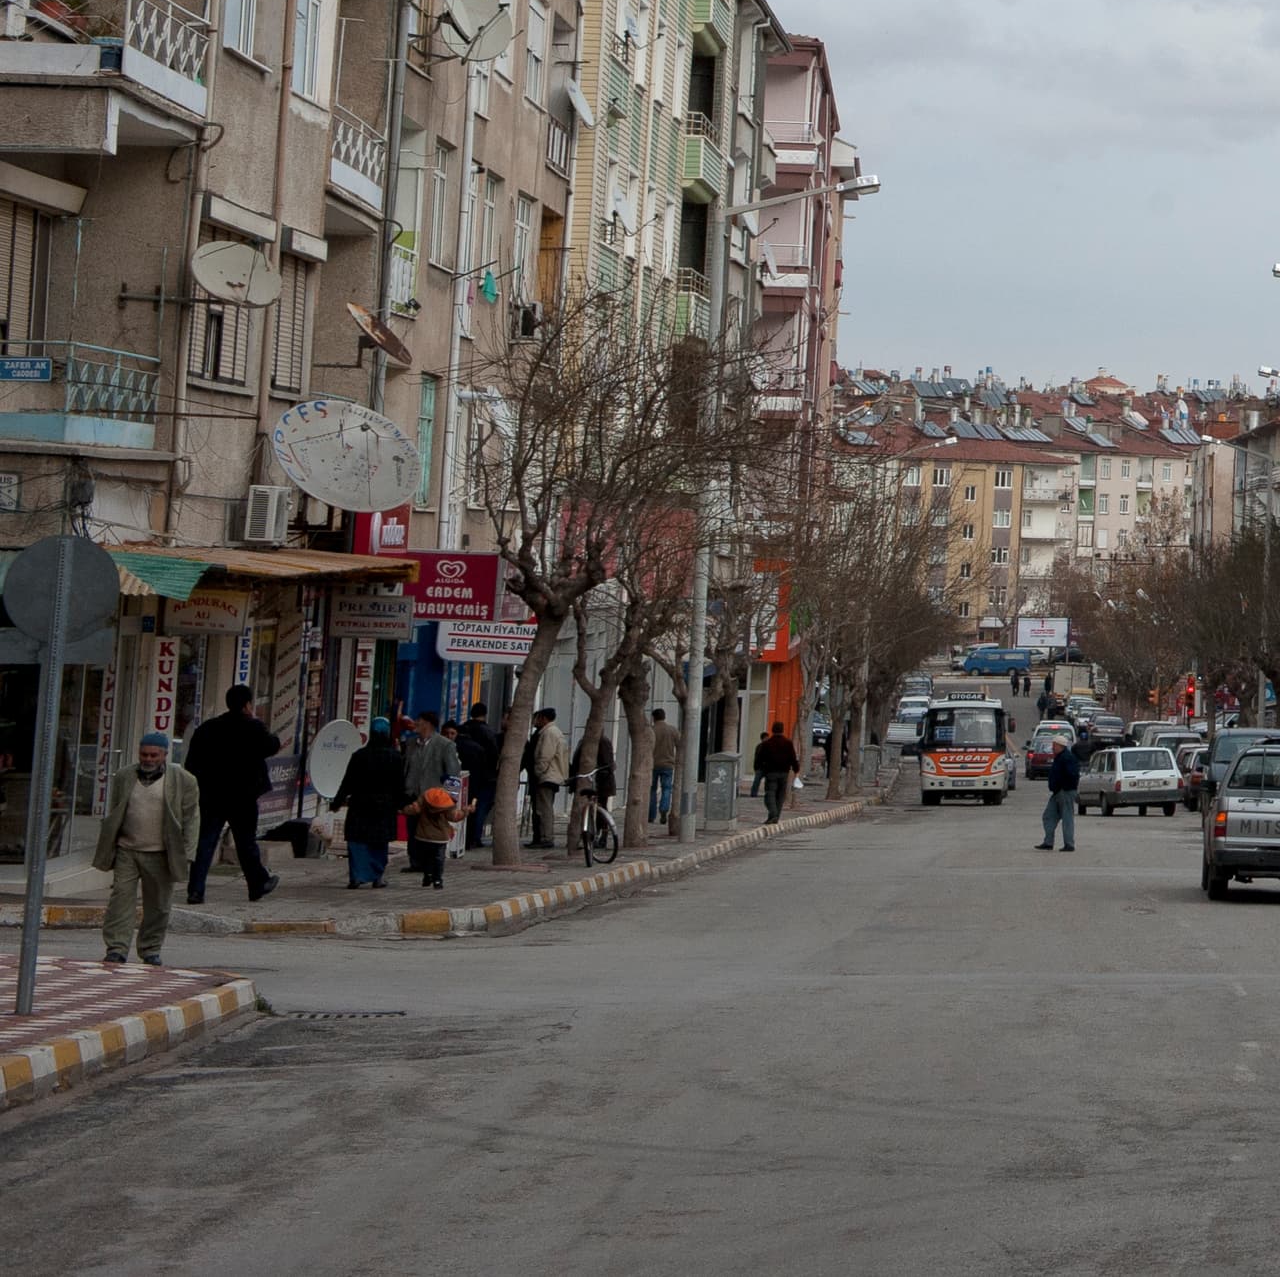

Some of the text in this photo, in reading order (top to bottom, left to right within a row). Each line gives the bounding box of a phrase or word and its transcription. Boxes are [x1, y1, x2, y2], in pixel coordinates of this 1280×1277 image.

[426, 586, 473, 599] ERDEM
[450, 638, 532, 652] PERAKENDE SATI
[238, 626, 252, 685] TELEV
[153, 641, 176, 731] KUNDU
[950, 692, 983, 700] OTOGAR
[939, 754, 990, 763] OTOGAR
